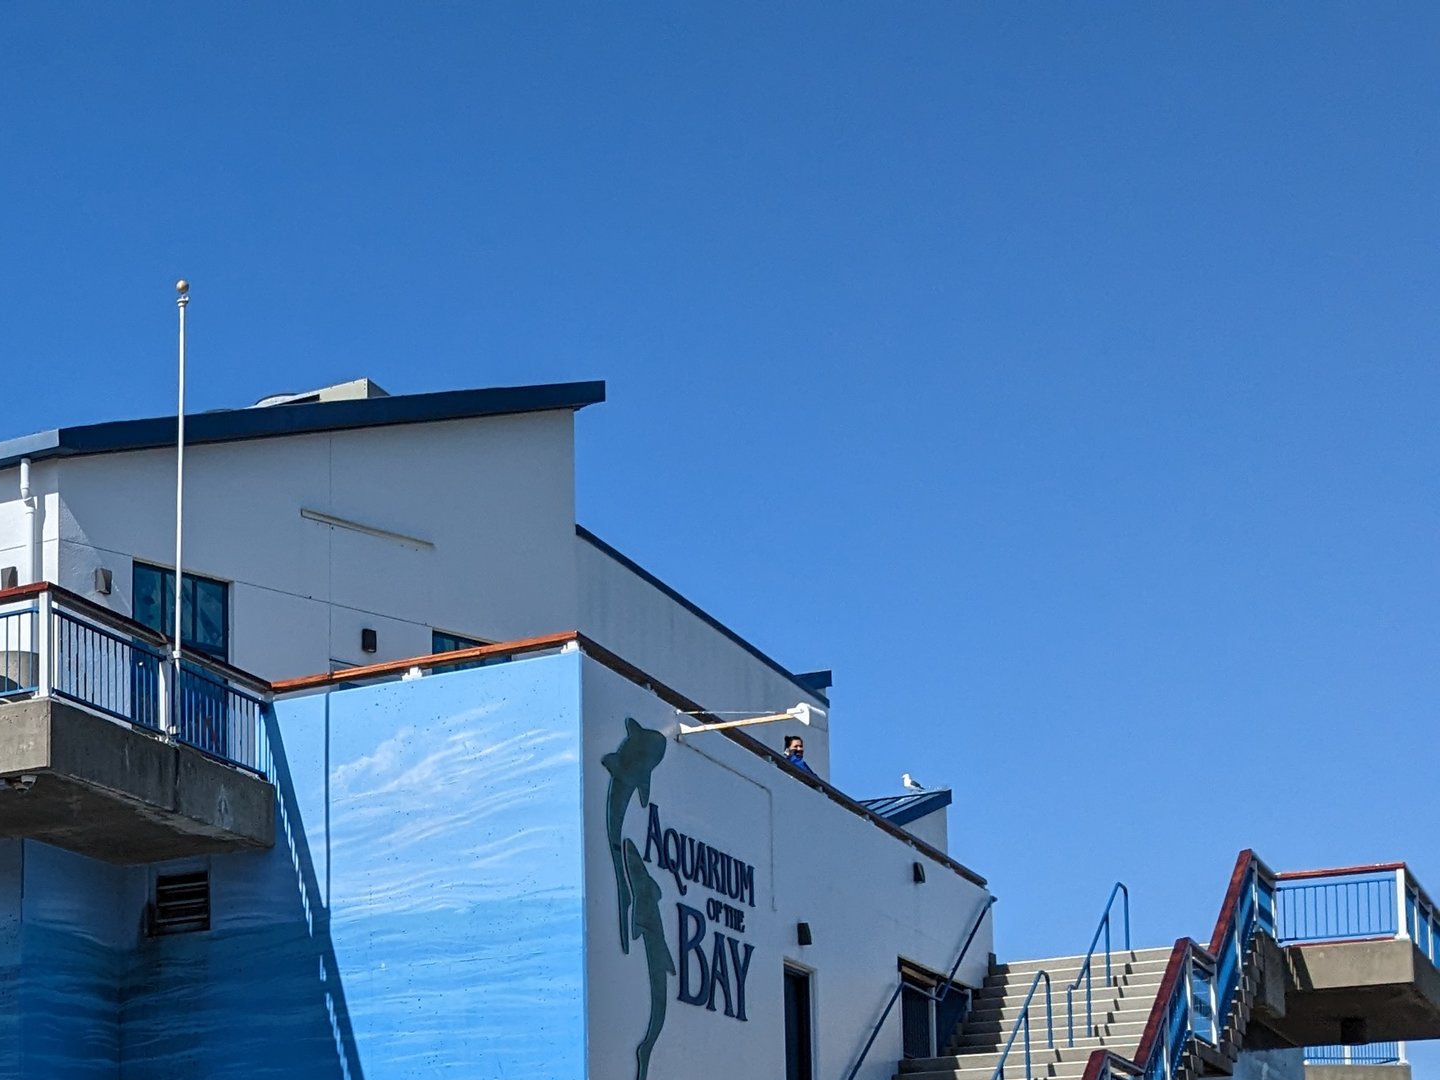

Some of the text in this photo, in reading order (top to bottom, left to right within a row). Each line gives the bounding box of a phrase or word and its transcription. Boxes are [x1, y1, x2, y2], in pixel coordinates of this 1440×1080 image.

[643, 803, 756, 908] AQUARIUM
[676, 902, 755, 1022] BAY
[706, 897, 745, 933] OF THE
